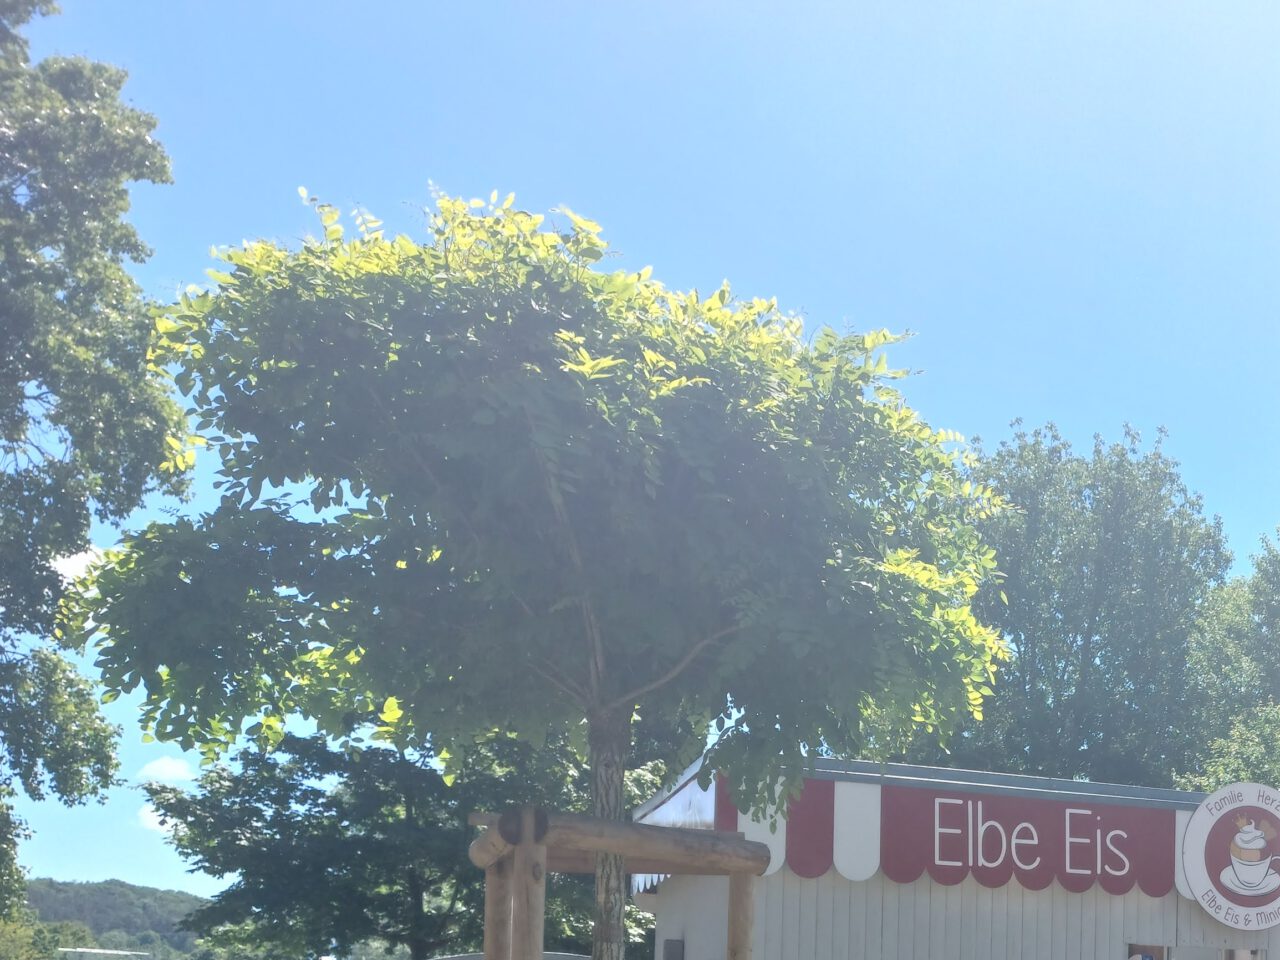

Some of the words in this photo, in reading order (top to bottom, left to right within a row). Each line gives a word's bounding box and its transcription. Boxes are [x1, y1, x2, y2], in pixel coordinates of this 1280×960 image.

[1205, 790, 1244, 816] Familie
[935, 797, 1041, 870] Elbe
[1065, 808, 1130, 876] Eis
[1201, 888, 1222, 914] Elbe
[1224, 906, 1239, 925] Eis
[1243, 914, 1252, 927] &
